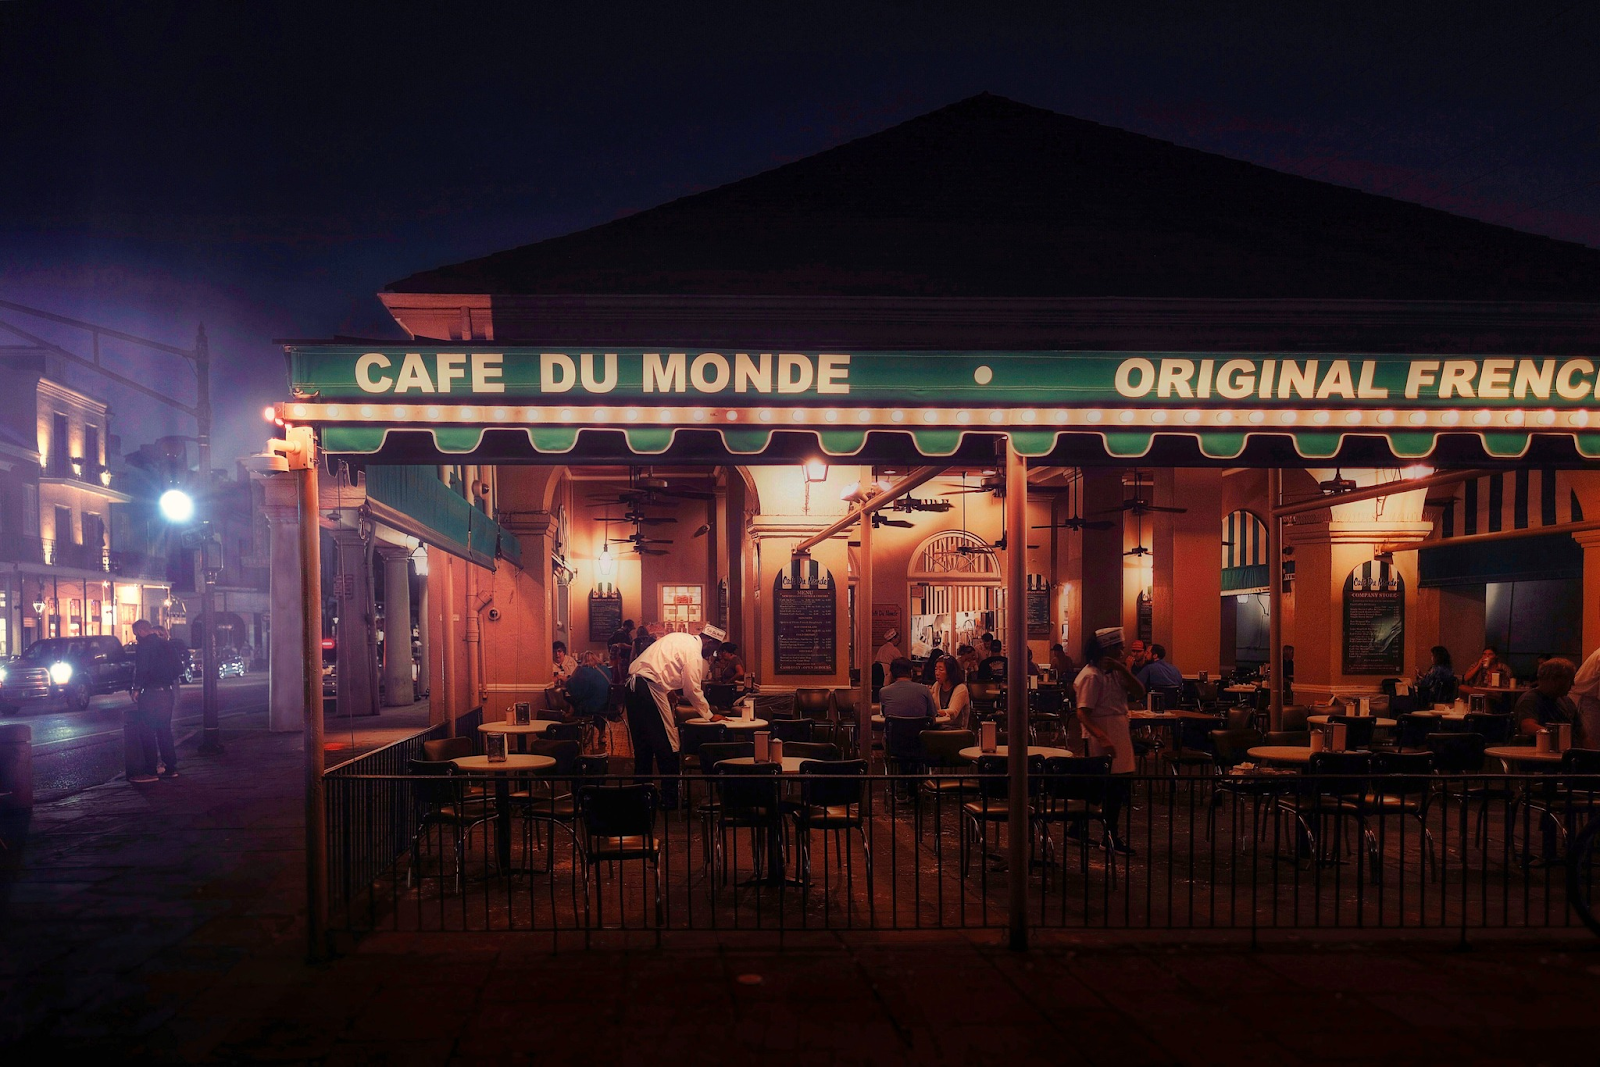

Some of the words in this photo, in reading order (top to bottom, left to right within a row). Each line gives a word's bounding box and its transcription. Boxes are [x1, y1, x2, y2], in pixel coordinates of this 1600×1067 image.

[355, 352, 505, 394] CAFE
[540, 353, 618, 394] DU
[642, 353, 851, 394] MONDE
[1114, 357, 1388, 399] ORIGINAL
[1405, 358, 1600, 400] FRENC
